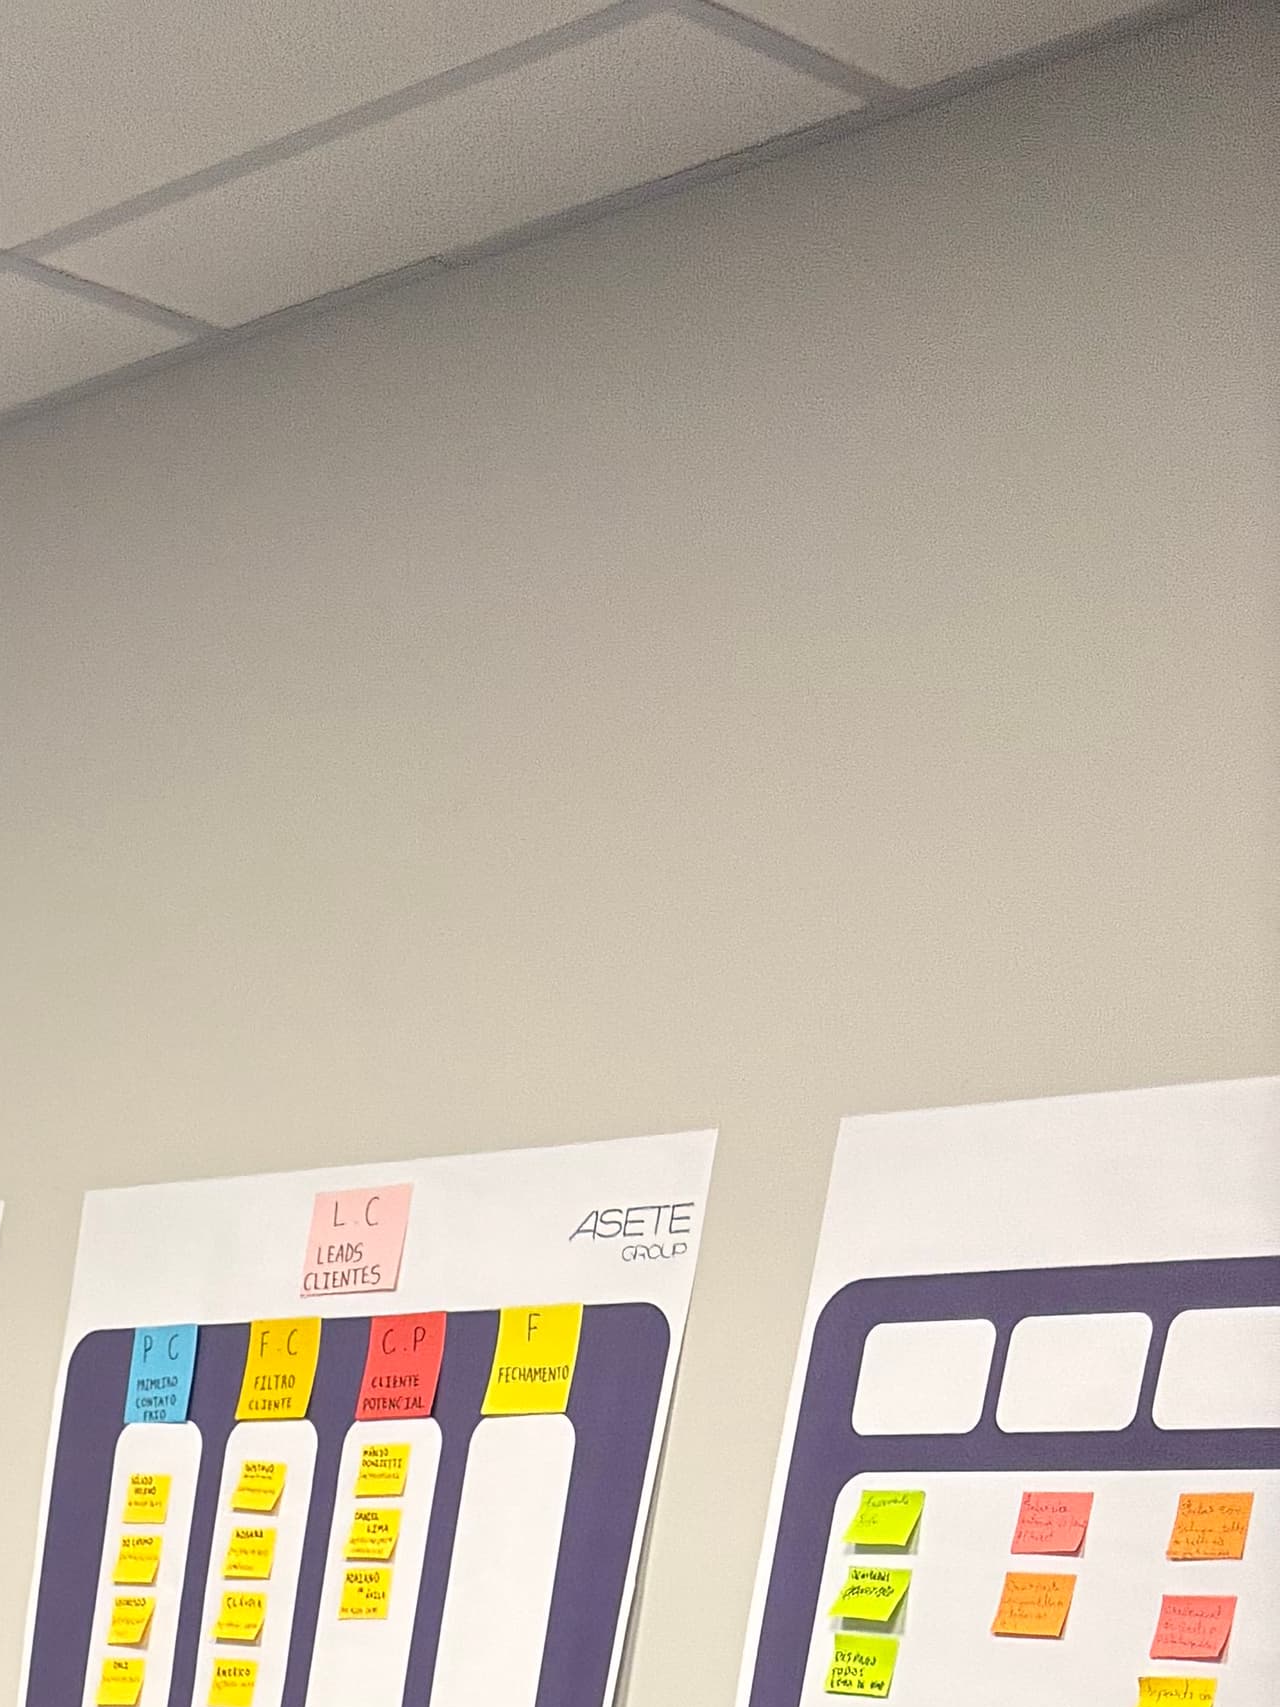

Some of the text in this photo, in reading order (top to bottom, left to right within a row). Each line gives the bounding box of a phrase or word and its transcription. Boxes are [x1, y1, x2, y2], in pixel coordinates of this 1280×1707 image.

[568, 1202, 695, 1242] ASETE
[316, 1241, 364, 1266] LEADS
[621, 1242, 688, 1263] GROUP
[303, 1263, 382, 1292] CLIENTES
[527, 1313, 541, 1342] F
[136, 1375, 179, 1392] PRIMEIRO
[254, 1374, 296, 1391] FILTRO
[370, 1373, 420, 1390] CLIENTE
[497, 1364, 570, 1386] FECHAMENTO
[136, 1393, 177, 1409] CONTATO
[248, 1397, 292, 1411] CLIENTE
[362, 1395, 424, 1411] POTENCIAL
[143, 1409, 167, 1422] FRIO
